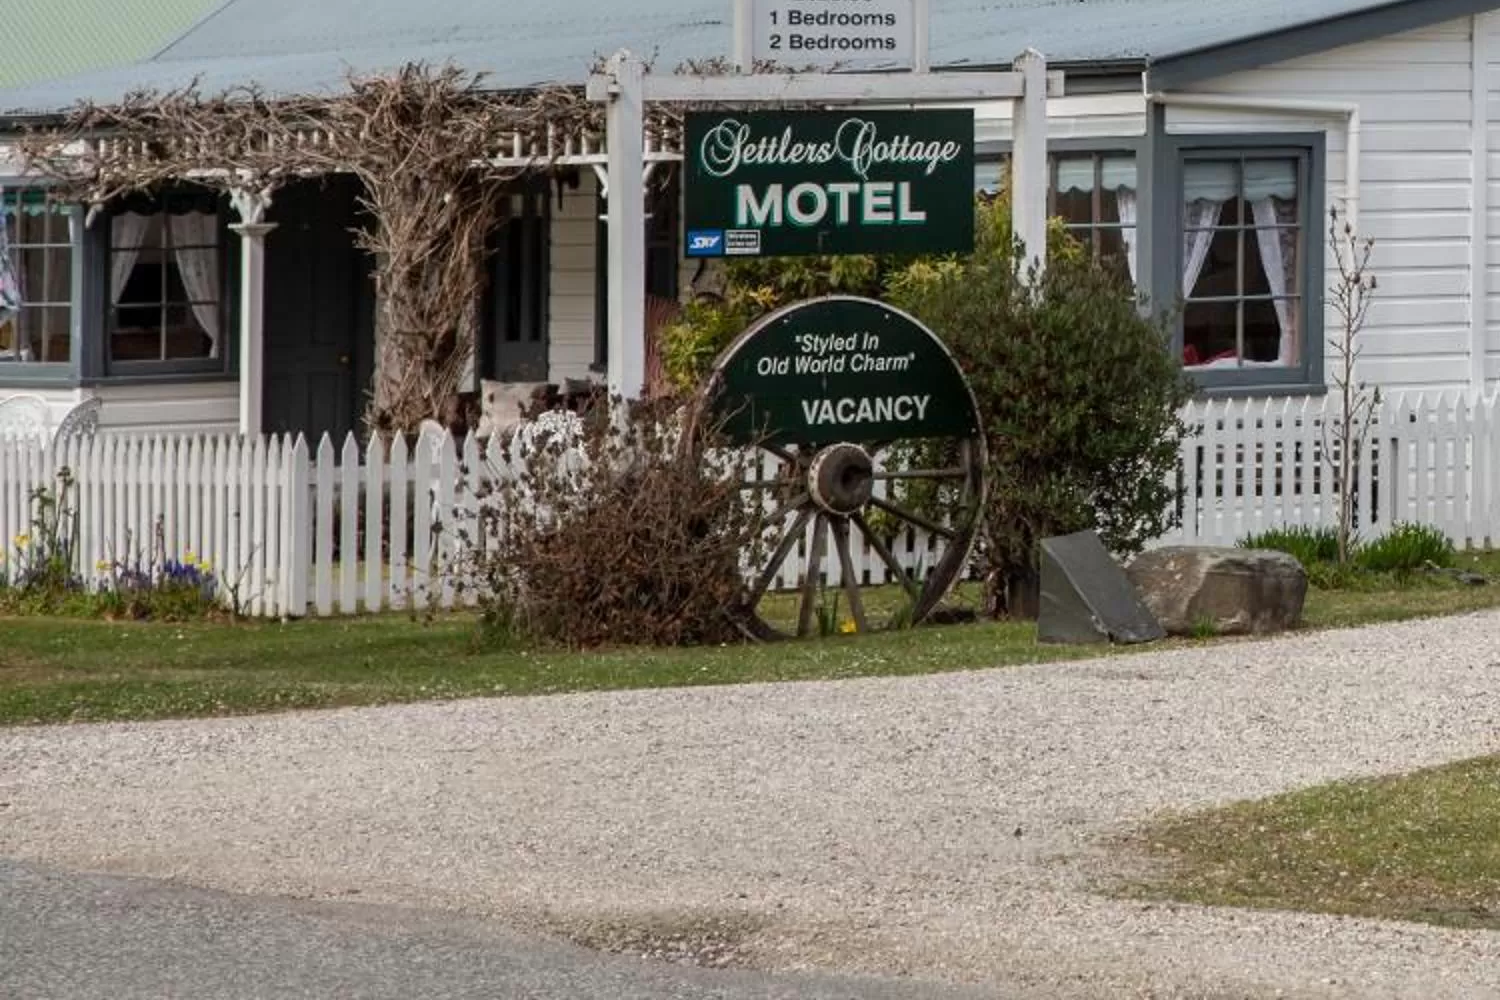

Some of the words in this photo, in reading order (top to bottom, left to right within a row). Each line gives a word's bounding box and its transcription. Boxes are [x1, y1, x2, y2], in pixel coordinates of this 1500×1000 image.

[769, 10, 777, 25] 1
[788, 10, 896, 26] Bedrooms
[770, 34, 781, 49] 2
[789, 34, 896, 50] Bedrooms
[701, 119, 836, 176] Settlers
[835, 118, 960, 180] Cottage
[737, 182, 926, 226] MOTEL
[863, 332, 879, 350] In
[757, 357, 788, 376] Old
[795, 354, 844, 374] World
[802, 394, 930, 425] VACANCY
